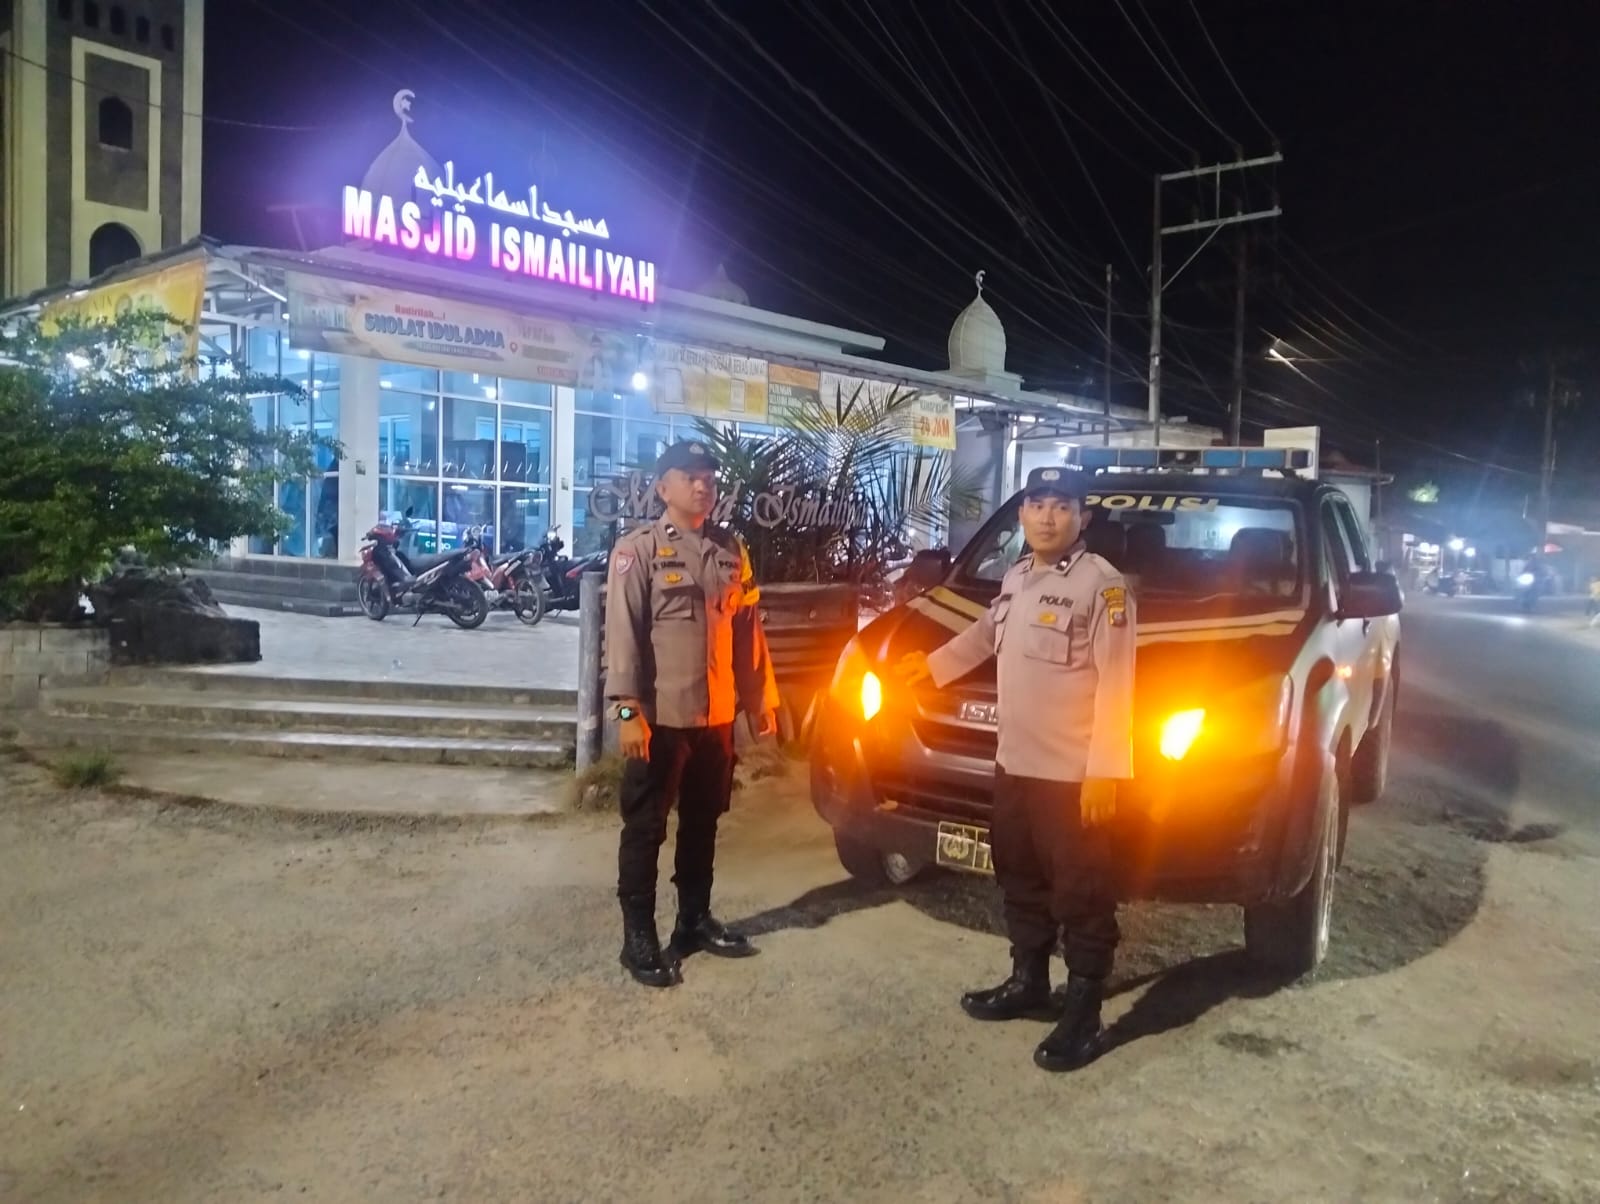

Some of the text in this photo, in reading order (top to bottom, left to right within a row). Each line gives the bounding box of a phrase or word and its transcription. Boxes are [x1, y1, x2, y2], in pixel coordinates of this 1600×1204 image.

[343, 185, 655, 303] MASJID ISMAILIYAH
[364, 312, 426, 338] SHOLAT
[427, 320, 464, 343] IDUL
[463, 326, 506, 349] ADHA
[1084, 494, 1219, 513] POLISI
[1038, 594, 1074, 609] POLRI
